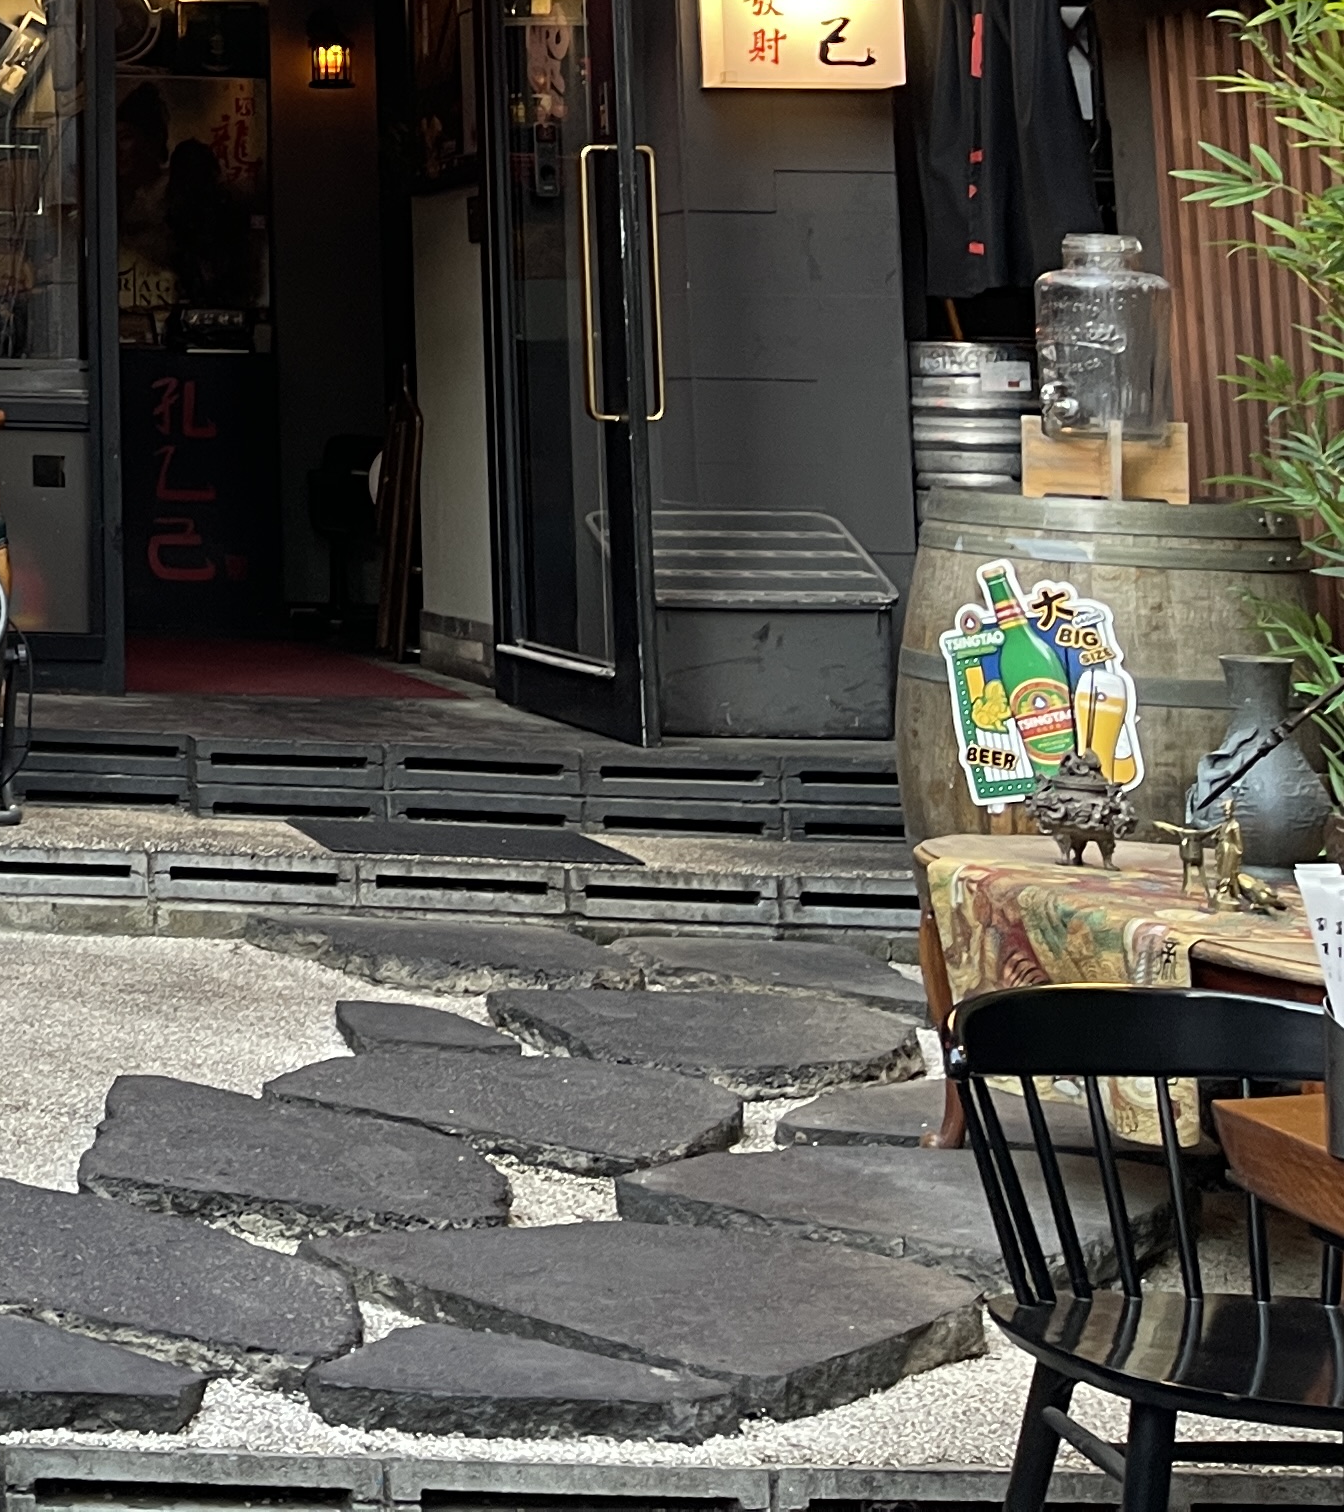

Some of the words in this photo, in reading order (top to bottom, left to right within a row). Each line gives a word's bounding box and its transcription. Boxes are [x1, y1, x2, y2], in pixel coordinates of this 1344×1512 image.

[1032, 589, 1074, 628] 大
[1057, 626, 1100, 647] BIG
[1080, 647, 1114, 664] SIZE
[966, 747, 1017, 769] BEER
